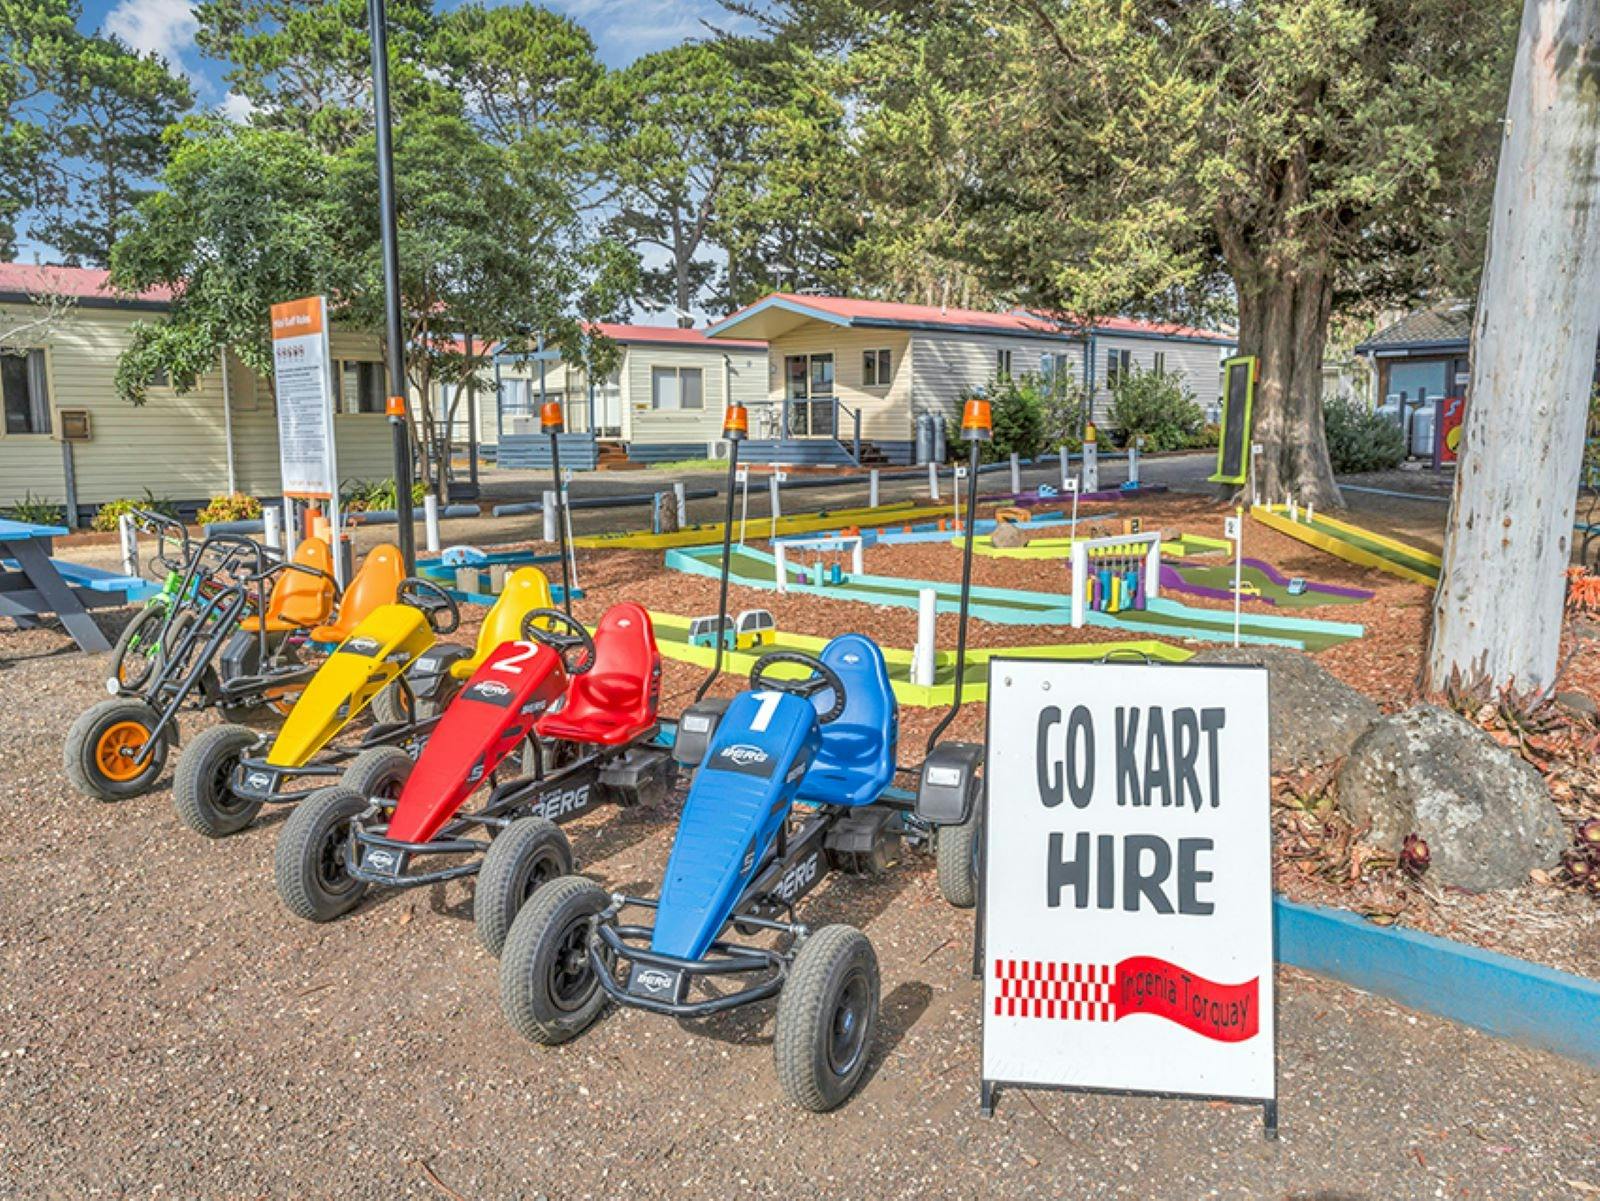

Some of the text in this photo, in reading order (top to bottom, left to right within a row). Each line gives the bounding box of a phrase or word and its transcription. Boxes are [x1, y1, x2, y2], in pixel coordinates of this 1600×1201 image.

[490, 641, 538, 673] 2
[749, 691, 784, 732] 1
[721, 747, 768, 763] BERG
[1036, 705, 1226, 813] GO KART
[1047, 832, 1215, 915] HIRE
[638, 974, 672, 989] BERG
[1121, 968, 1250, 1033] Ingenia Torquay
